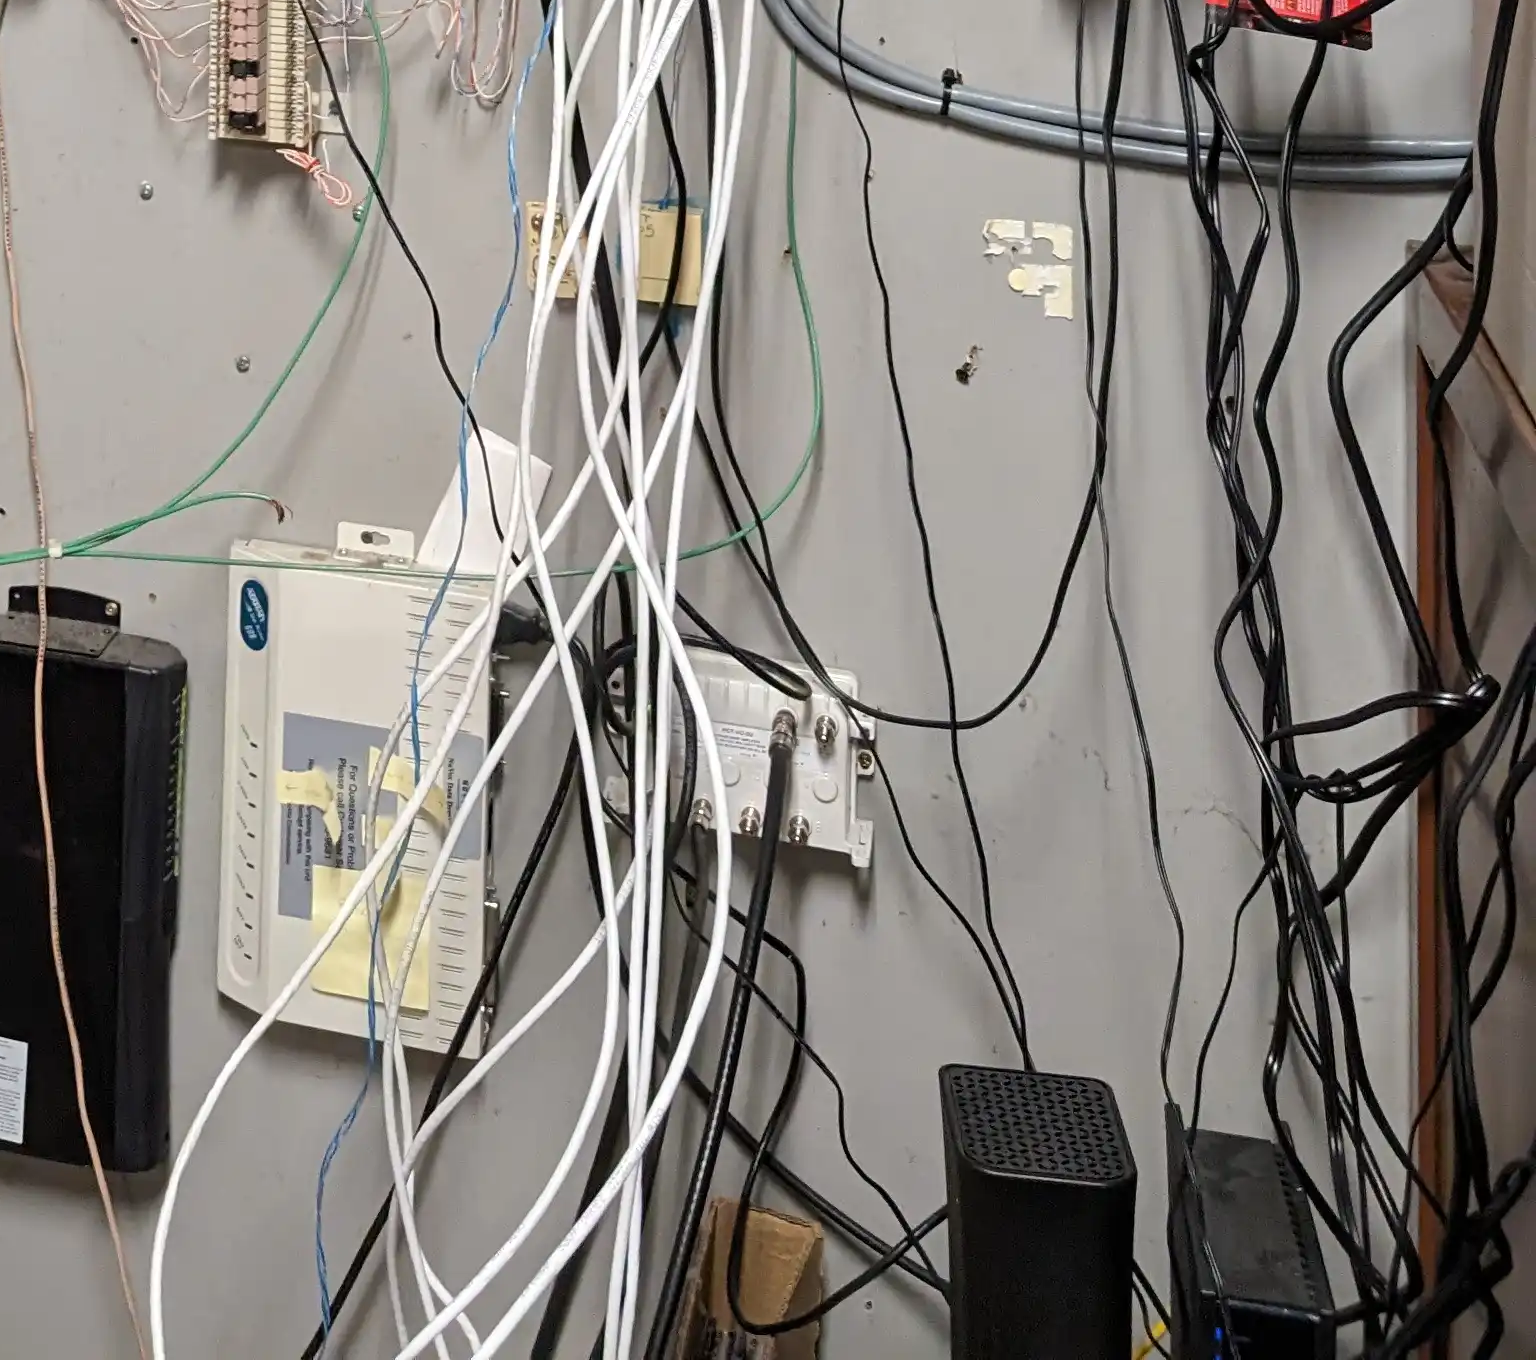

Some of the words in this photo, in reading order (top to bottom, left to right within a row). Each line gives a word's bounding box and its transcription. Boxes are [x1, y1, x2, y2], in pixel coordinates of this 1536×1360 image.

[337, 757, 347, 789] Please
[349, 765, 359, 781] For
[336, 791, 345, 808] call
[348, 783, 358, 831] Questions
[347, 832, 356, 842] or
